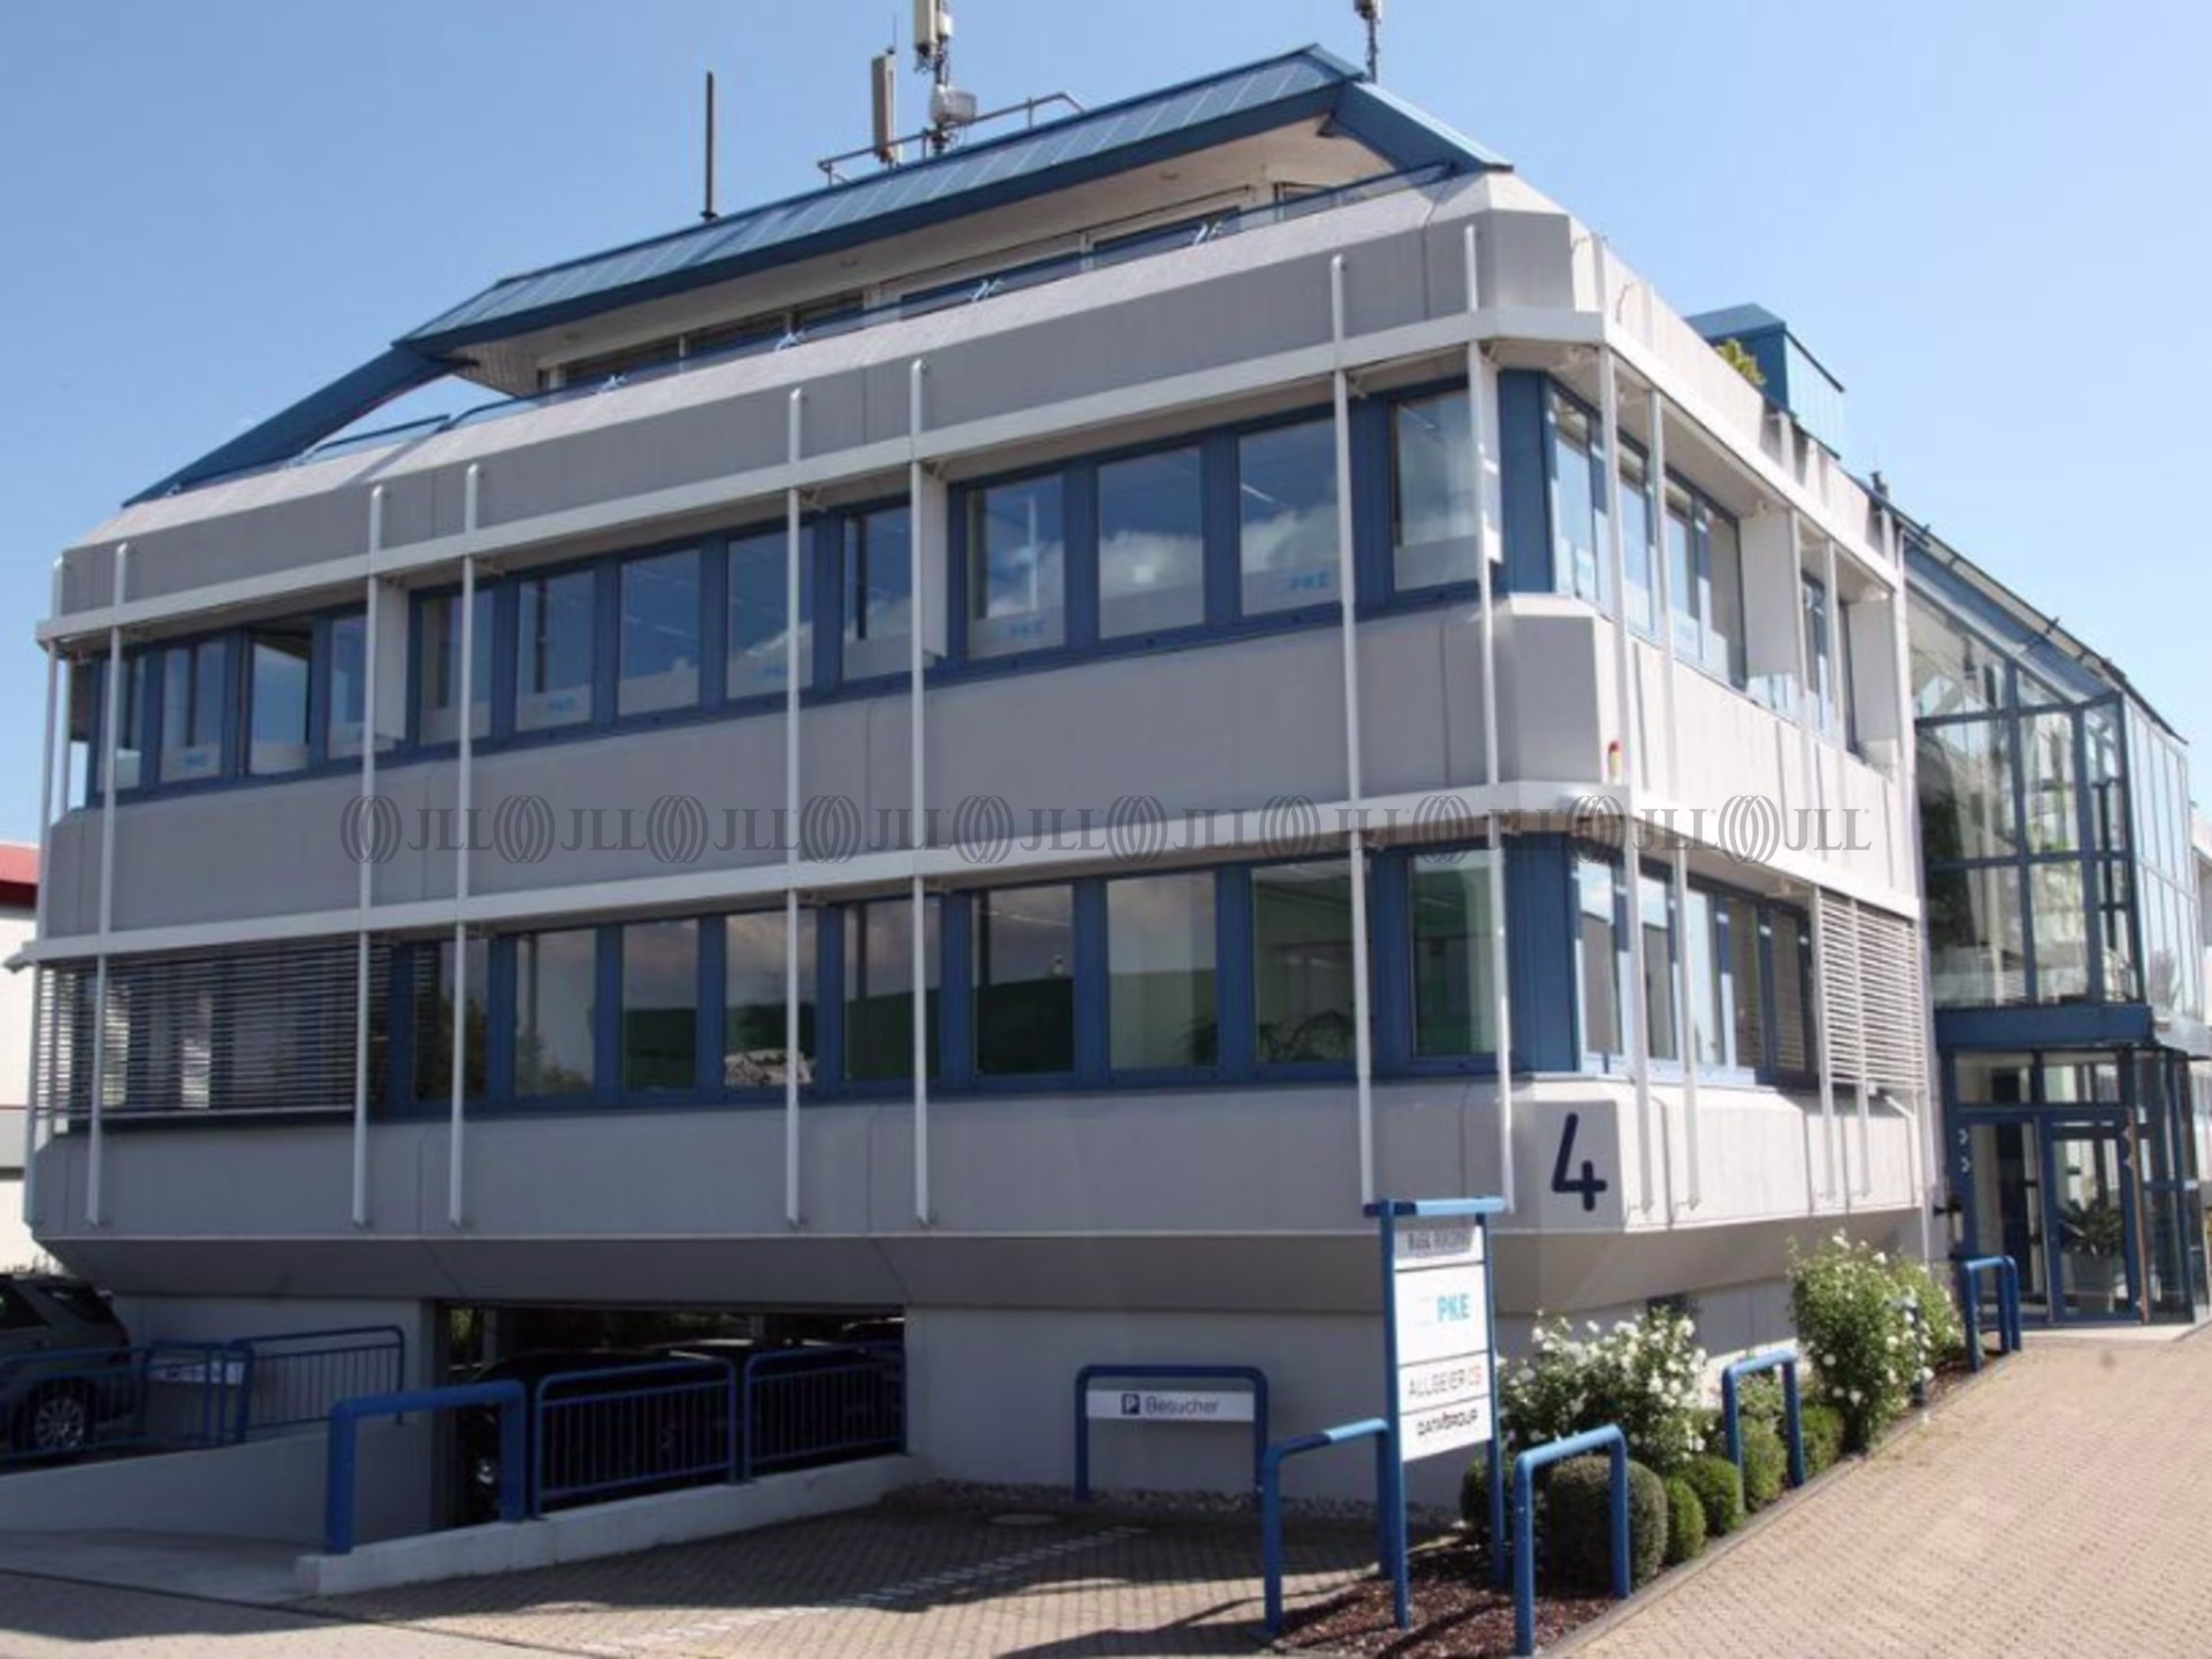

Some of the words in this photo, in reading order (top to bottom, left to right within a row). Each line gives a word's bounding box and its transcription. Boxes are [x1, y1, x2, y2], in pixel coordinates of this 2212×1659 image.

[1551, 1112, 1608, 1212] 4
[1438, 1293, 1471, 1323] PKE
[1146, 1395, 1221, 1415] Besucher
